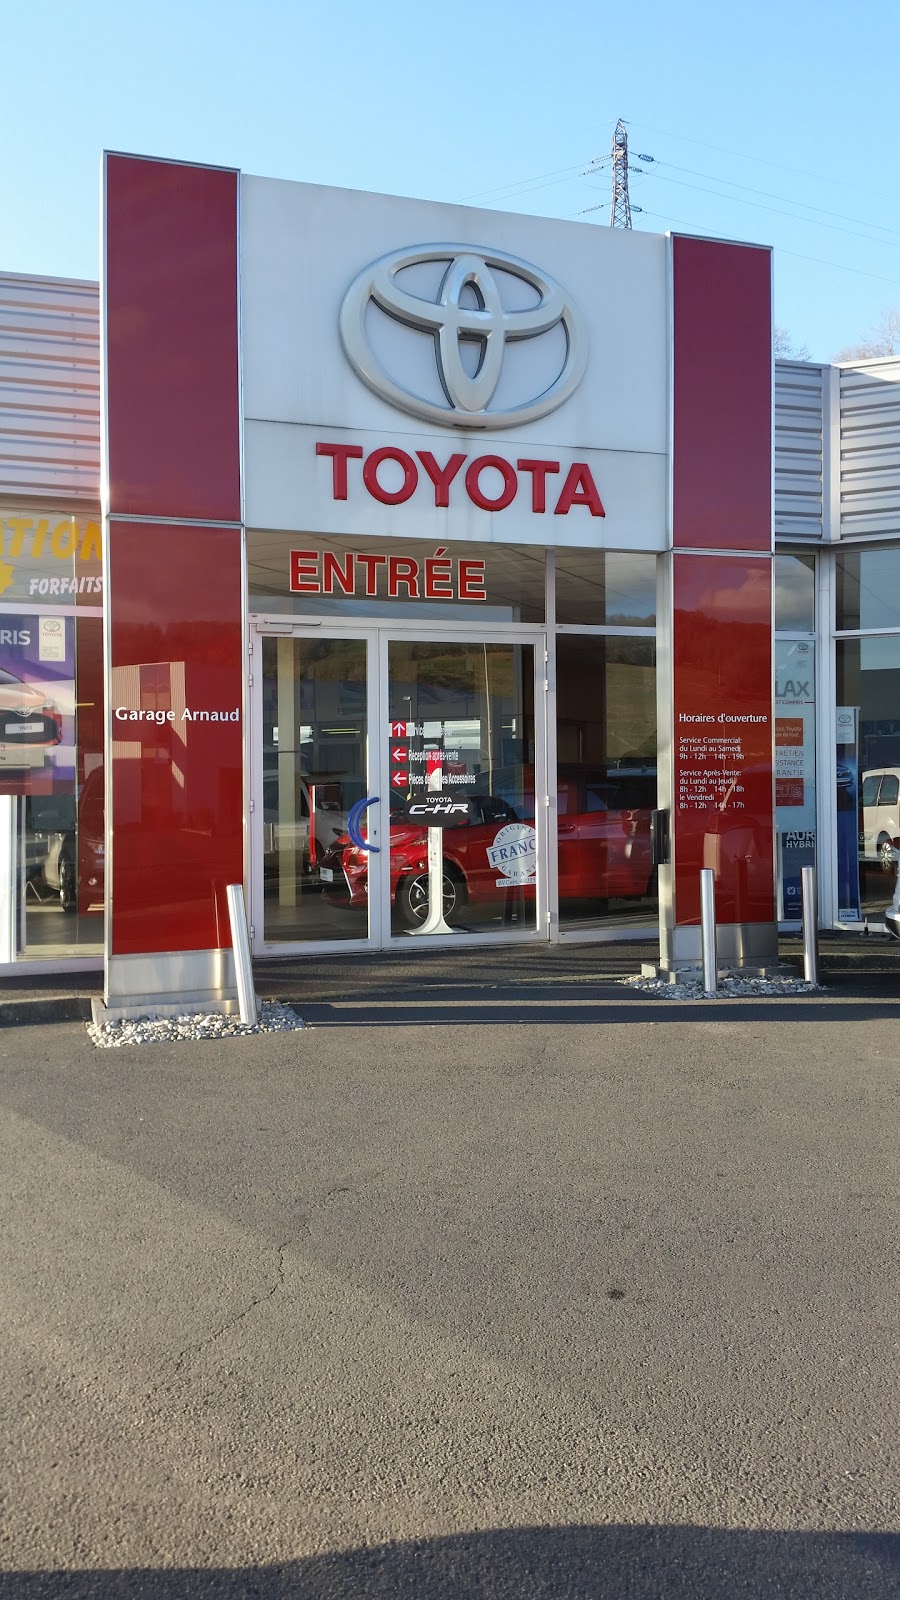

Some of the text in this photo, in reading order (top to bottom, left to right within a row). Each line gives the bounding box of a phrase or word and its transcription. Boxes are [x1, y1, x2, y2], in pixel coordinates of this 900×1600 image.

[315, 442, 606, 518] TOYOTA
[0, 518, 102, 560] TION
[289, 547, 487, 600] ENTRÉE
[29, 576, 103, 595] FORFAITS
[0, 630, 31, 646] RIS
[115, 707, 240, 725] Garage Arnaud
[679, 713, 767, 723] Horaires d'ouverture
[703, 769, 742, 778] Après-Vente:
[409, 804, 469, 814] C-HR
[491, 838, 536, 863] FRANC
